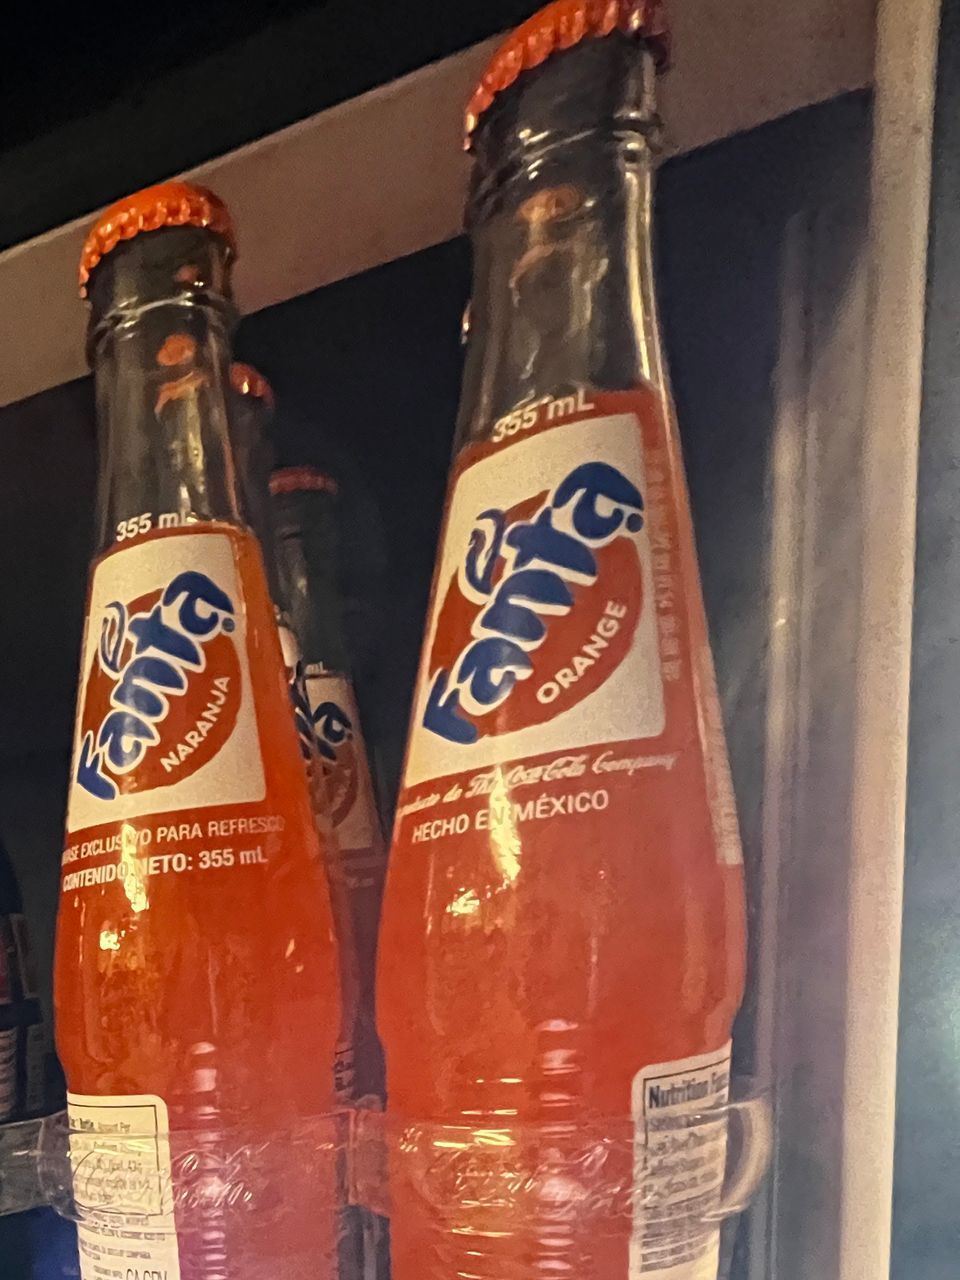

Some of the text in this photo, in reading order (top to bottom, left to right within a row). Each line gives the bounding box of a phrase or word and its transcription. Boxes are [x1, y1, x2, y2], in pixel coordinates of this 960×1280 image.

[491, 391, 594, 443] 355 mL
[116, 513, 152, 542] 355
[422, 461, 644, 745] Fanta
[535, 599, 628, 705] ORANGE
[76, 570, 235, 801] Fanta
[160, 676, 231, 772] NARANJA
[80, 815, 285, 859] EXCLUSVO PARA REFRESCO
[412, 812, 469, 844] HECHO
[512, 789, 611, 823] MÉXICO
[198, 848, 235, 869] 355
[239, 846, 269, 865] mL
[648, 1078, 710, 1110] Nutrition
